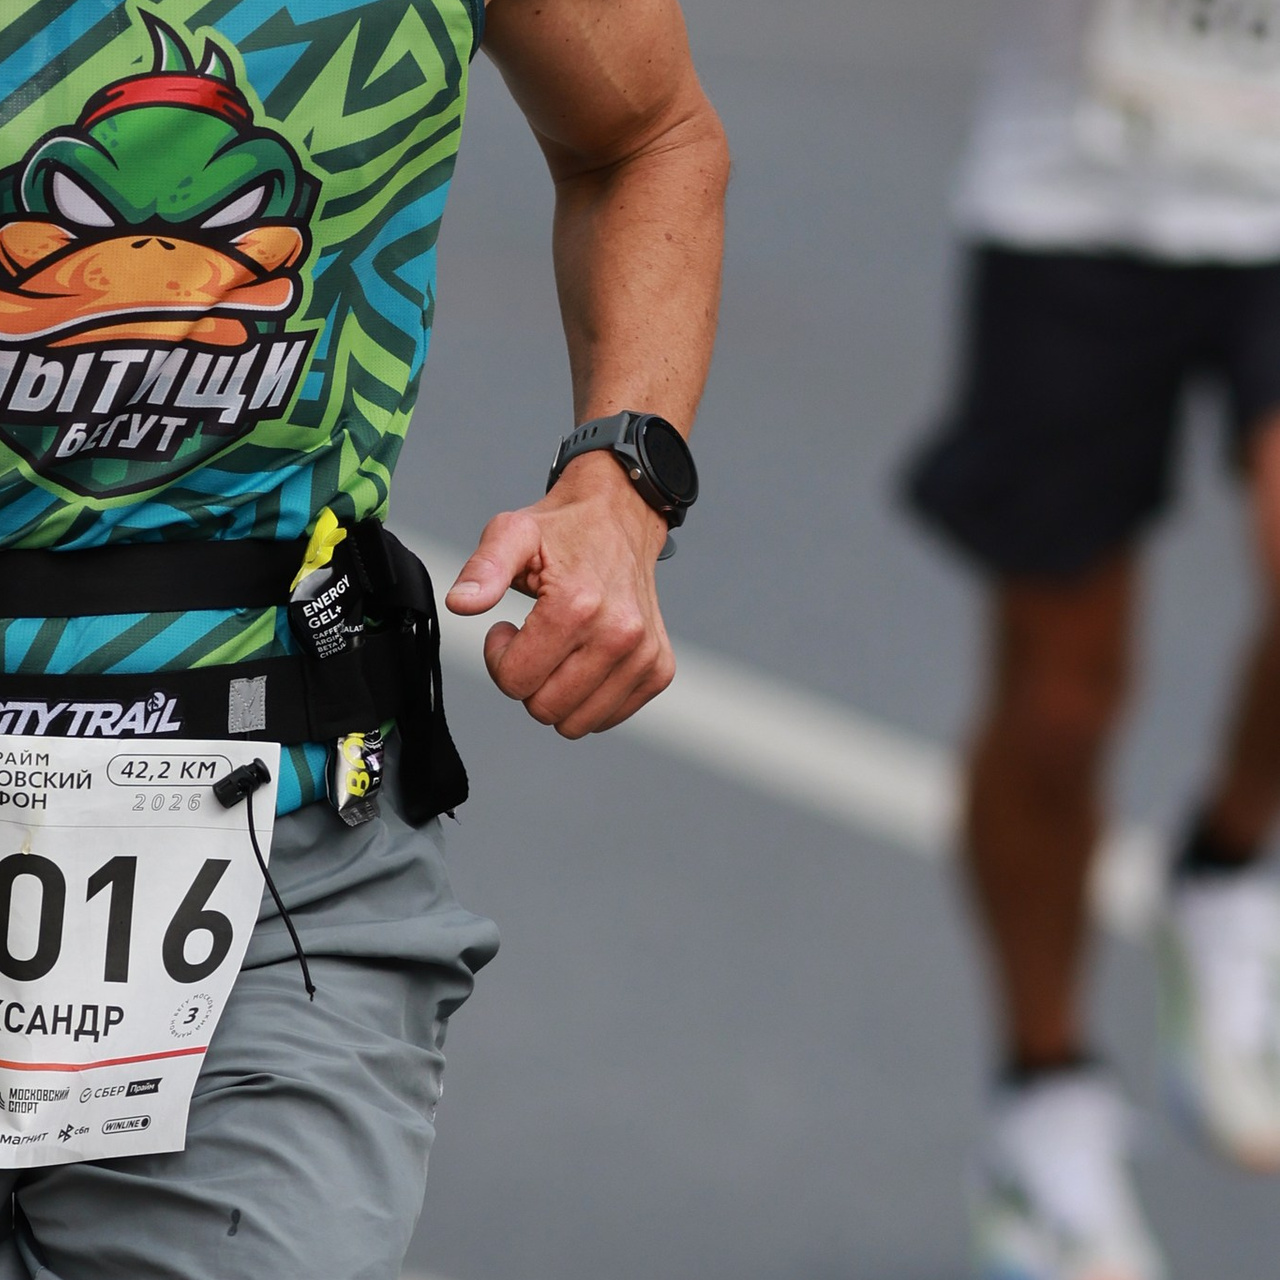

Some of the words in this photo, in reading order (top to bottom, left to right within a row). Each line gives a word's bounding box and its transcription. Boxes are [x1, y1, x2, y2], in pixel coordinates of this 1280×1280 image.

[55, 413, 188, 458] БЕГУТ
[302, 574, 350, 617] ENERGY
[308, 605, 342, 629] GEL+
[317, 641, 338, 653] BETA
[120, 761, 170, 781] 42,2
[180, 760, 217, 780] КМ
[132, 793, 202, 812] 2026
[183, 1007, 199, 1024] 3
[9, 1086, 70, 1102] МОСКОВСКИЙ
[94, 1085, 126, 1098] СБЕР
[130, 1082, 156, 1094] Прайм
[8, 1100, 39, 1114] СПОРТ
[105, 1119, 141, 1132] WINLINE
